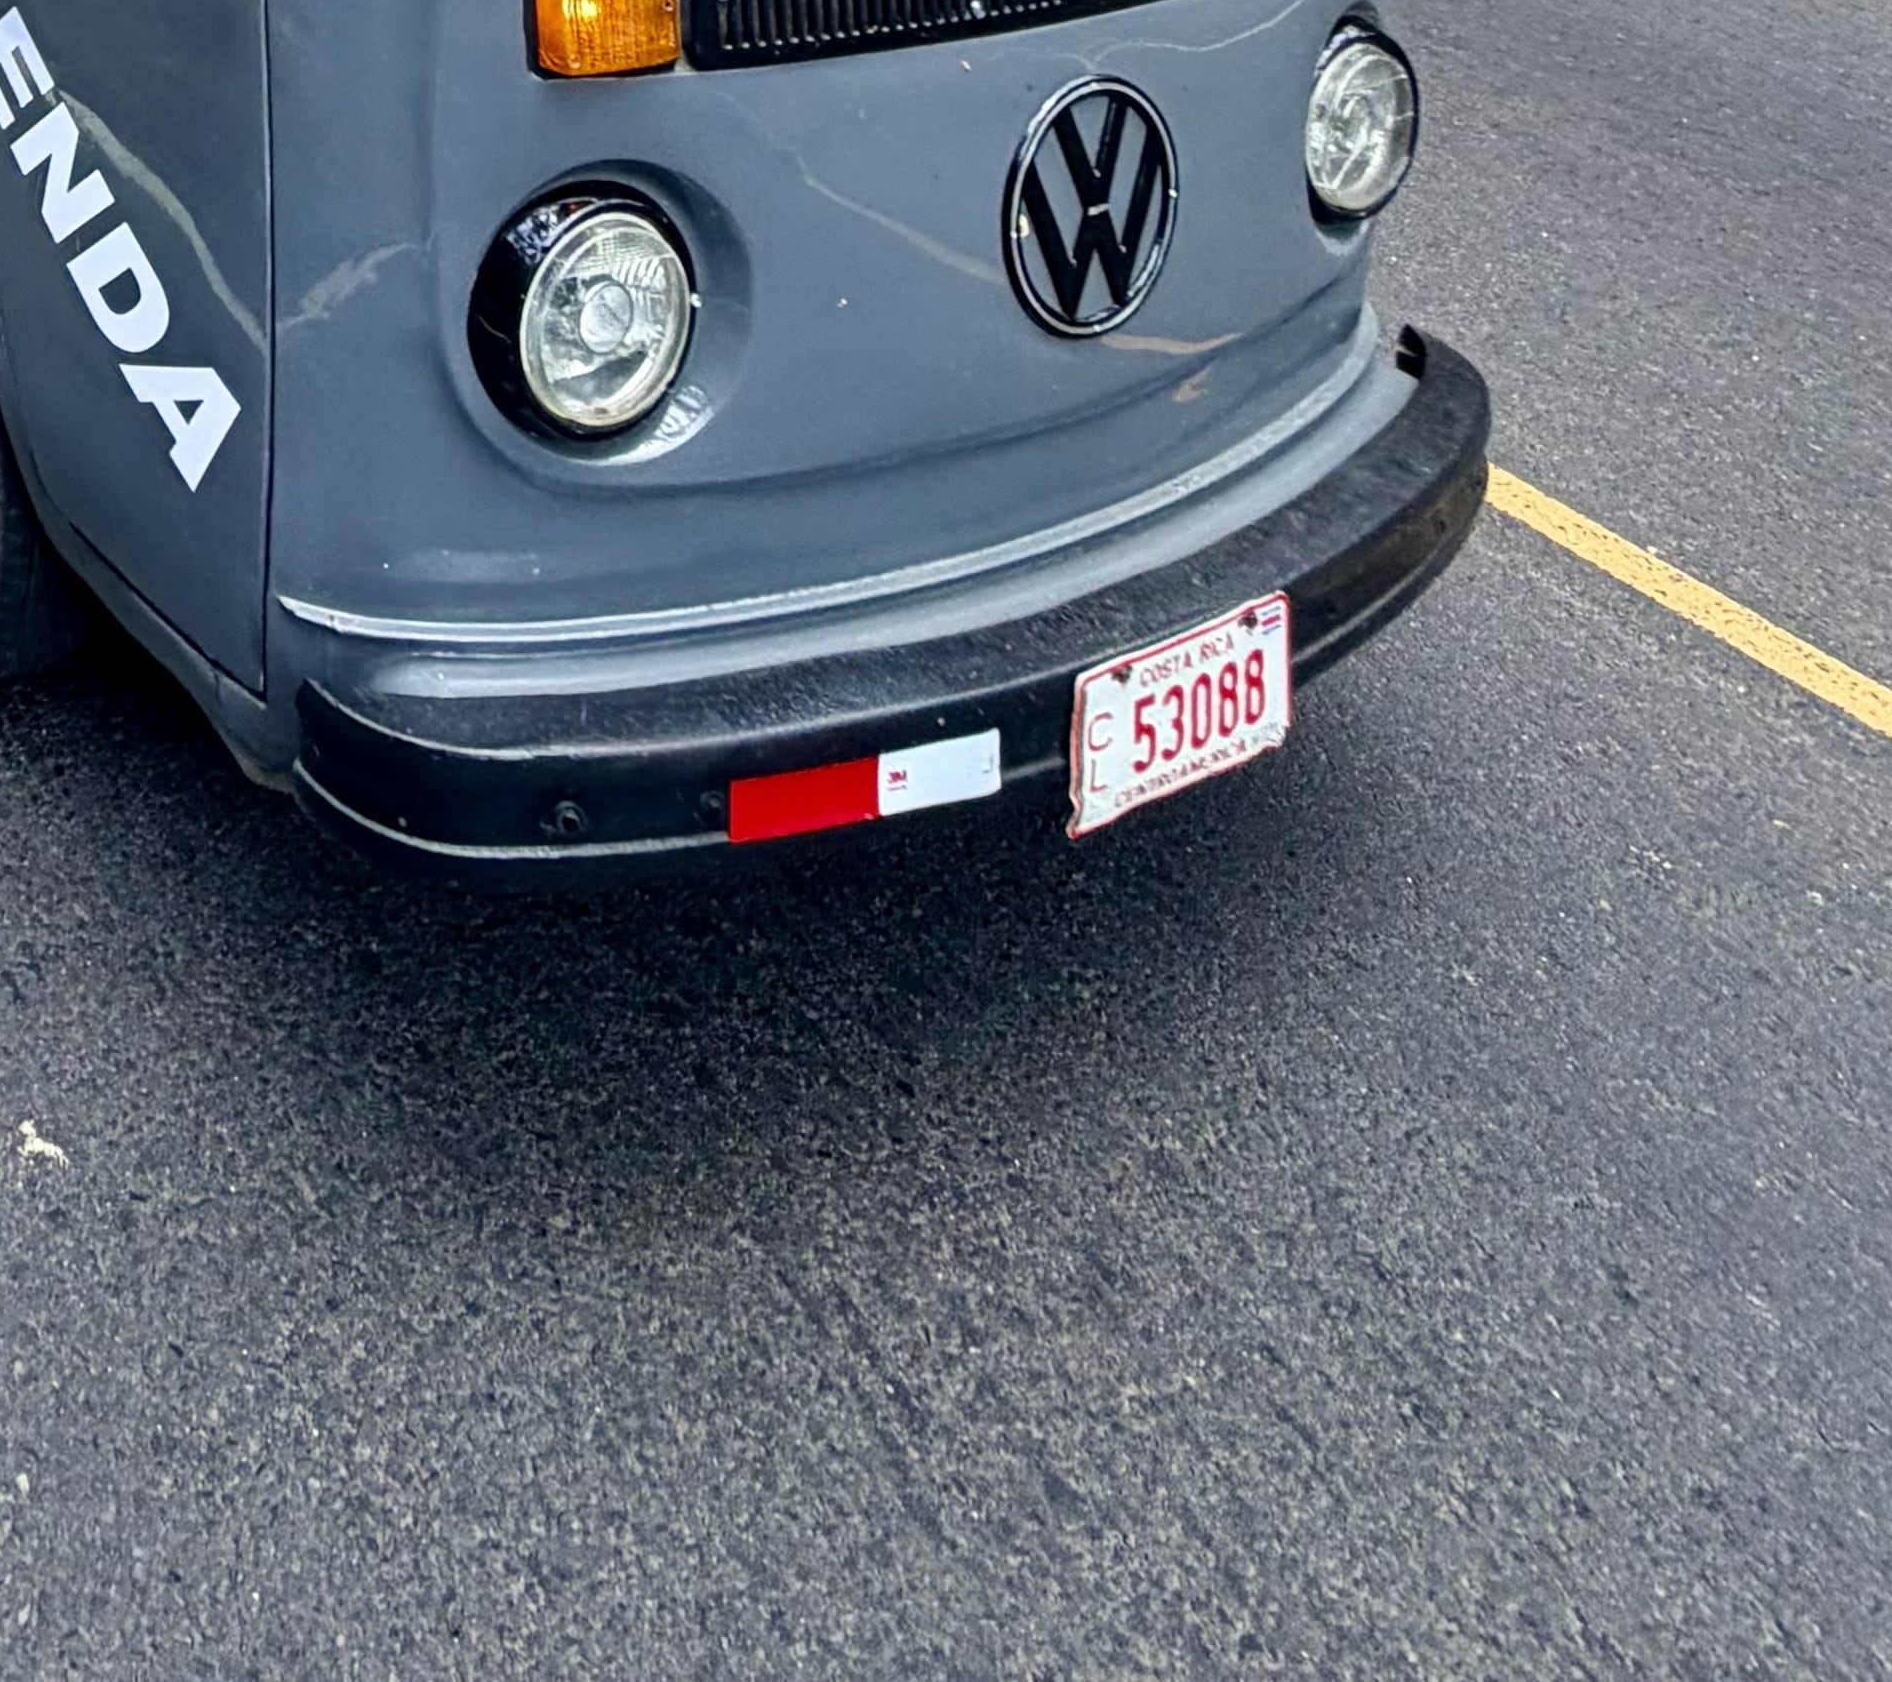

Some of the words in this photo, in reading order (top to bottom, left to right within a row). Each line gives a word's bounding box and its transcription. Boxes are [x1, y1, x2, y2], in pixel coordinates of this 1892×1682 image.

[1139, 650, 1194, 688] COSTA
[1199, 633, 1235, 664] RICA
[1132, 648, 1266, 774] 53088
